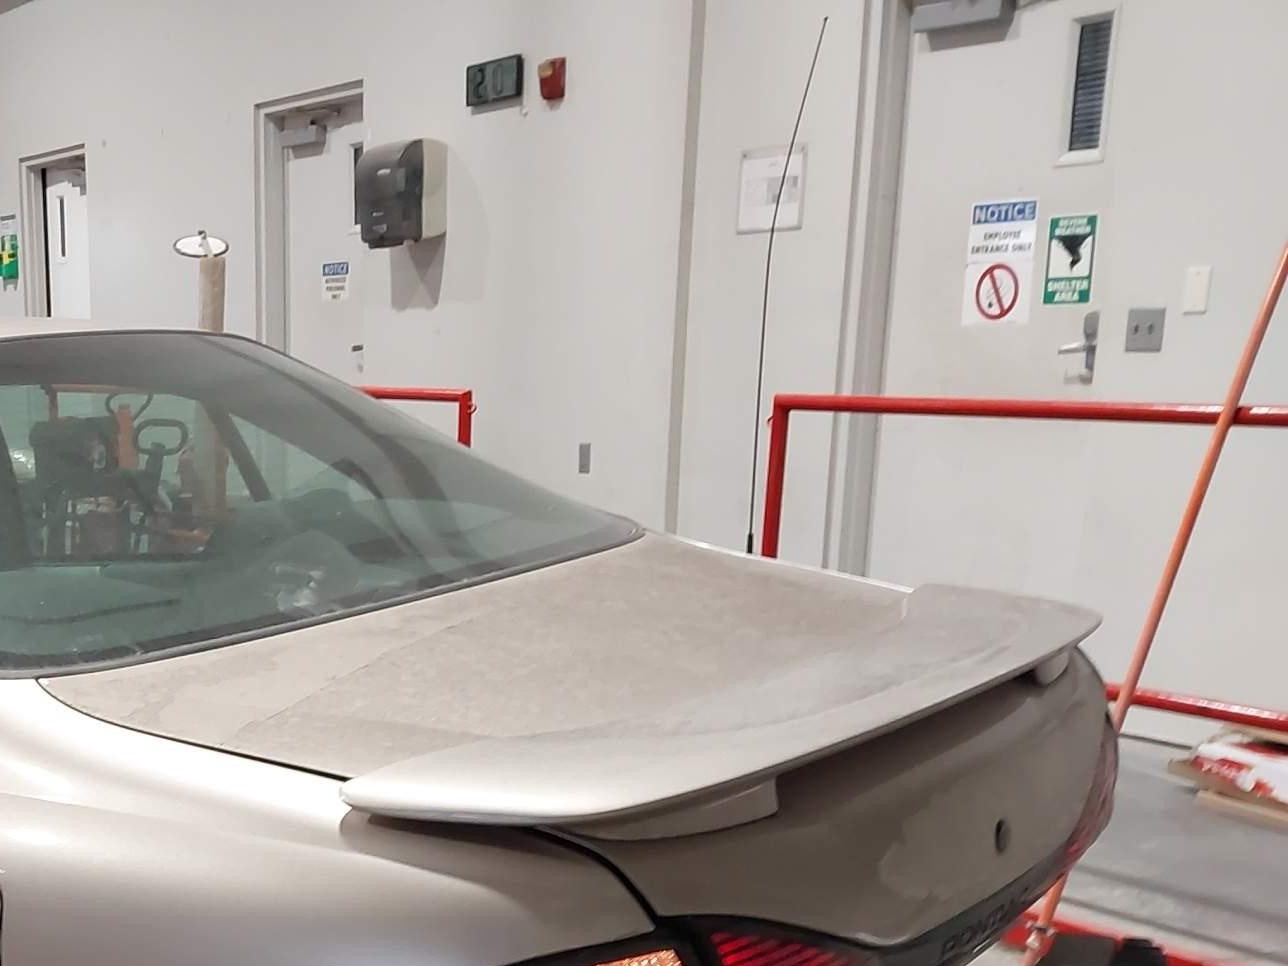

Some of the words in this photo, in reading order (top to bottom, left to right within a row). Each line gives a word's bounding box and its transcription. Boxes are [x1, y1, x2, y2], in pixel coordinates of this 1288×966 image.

[975, 203, 1035, 223] NOTICE
[983, 230, 1022, 241] EMPLOYEE
[971, 244, 1009, 255] ENTRANCE
[1011, 242, 1032, 253] ONLY
[1047, 279, 1089, 291] SHELTER
